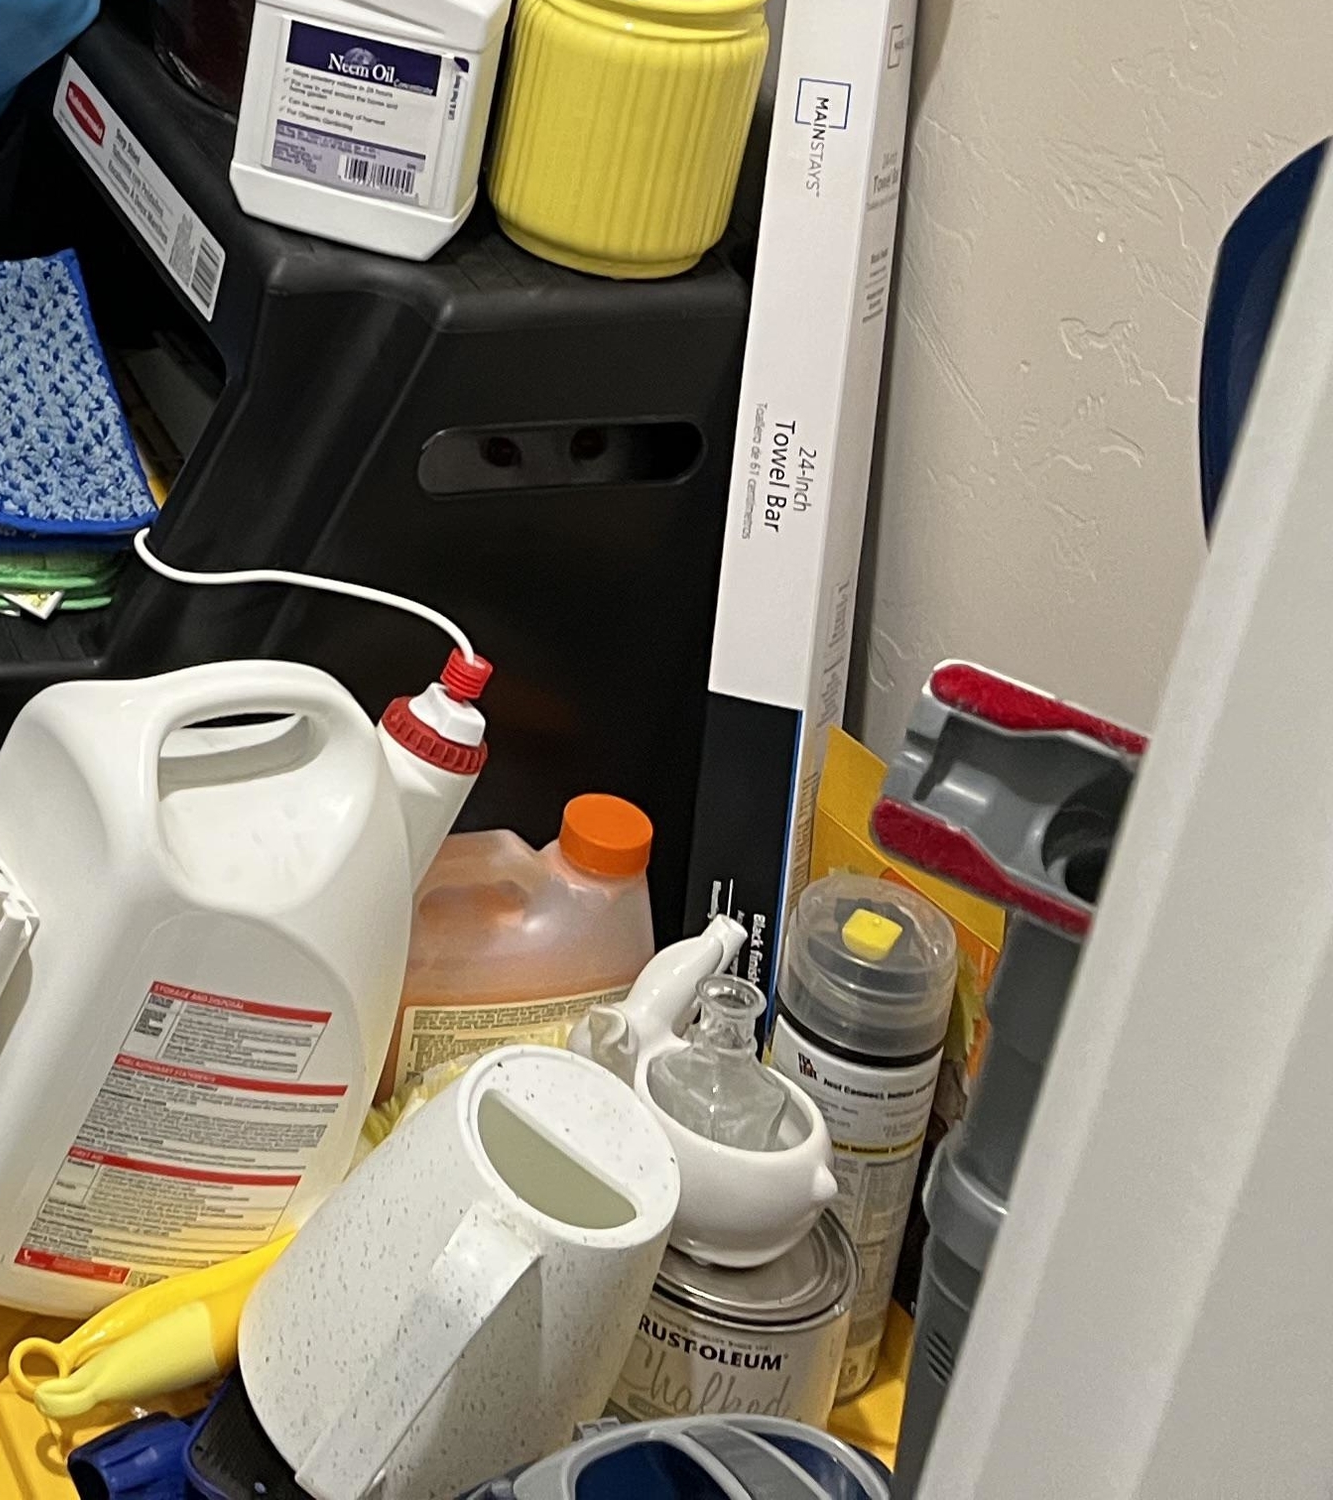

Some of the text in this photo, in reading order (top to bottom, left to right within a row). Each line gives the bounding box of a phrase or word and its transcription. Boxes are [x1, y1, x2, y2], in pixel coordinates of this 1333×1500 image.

[328, 53, 395, 83] Neem Oil
[805, 96, 830, 192] MAINSTAYS
[764, 420, 796, 533] Towel Bar
[793, 446, 817, 513] 24-Inch
[750, 913, 766, 949] Black
